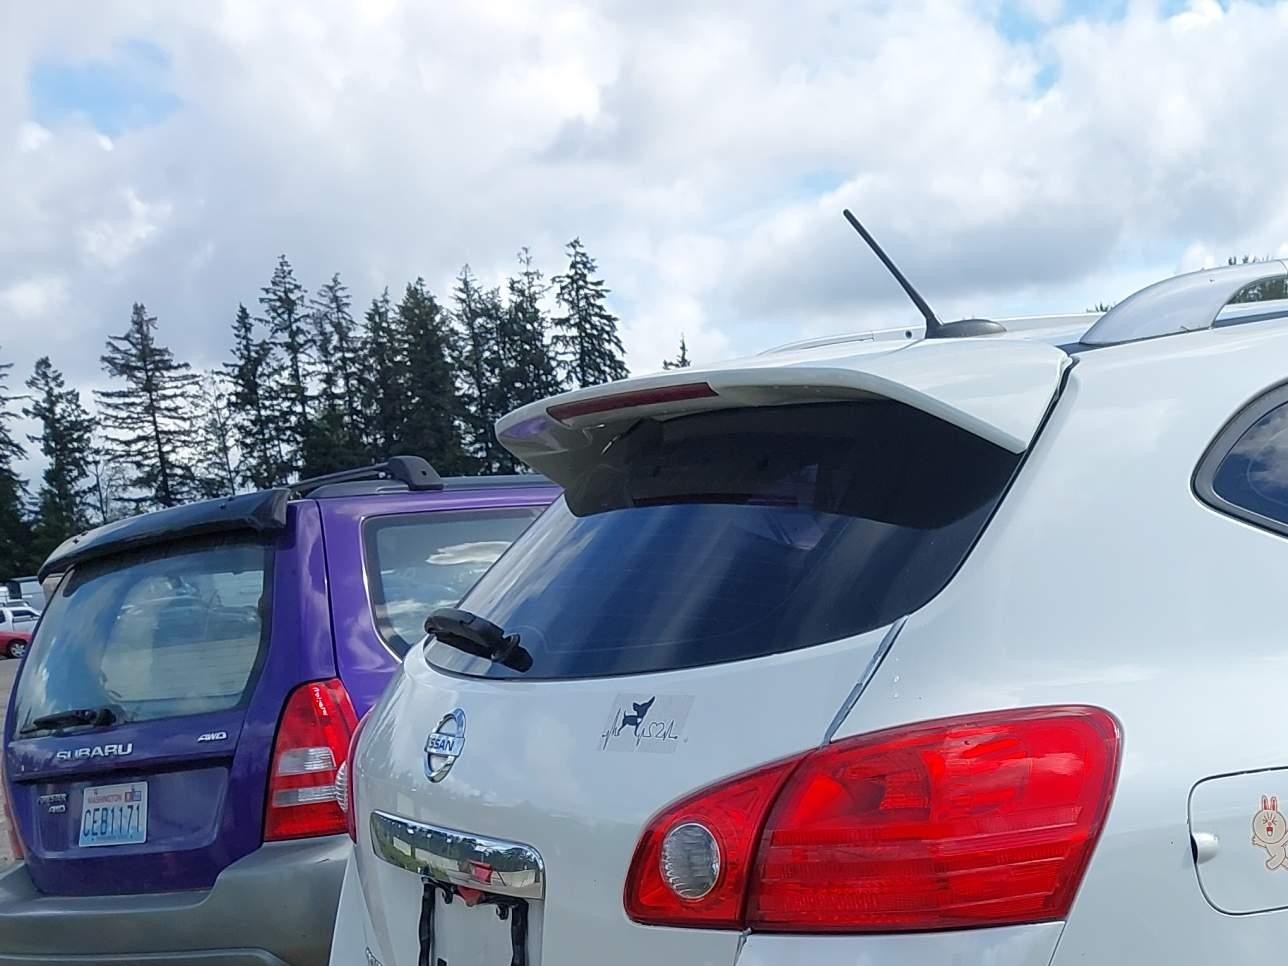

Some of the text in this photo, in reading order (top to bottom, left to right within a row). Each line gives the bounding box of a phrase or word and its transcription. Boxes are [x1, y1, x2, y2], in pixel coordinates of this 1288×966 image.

[197, 731, 227, 742] AWD
[56, 743, 133, 760] SUBARU
[83, 804, 141, 837] CEB1171
